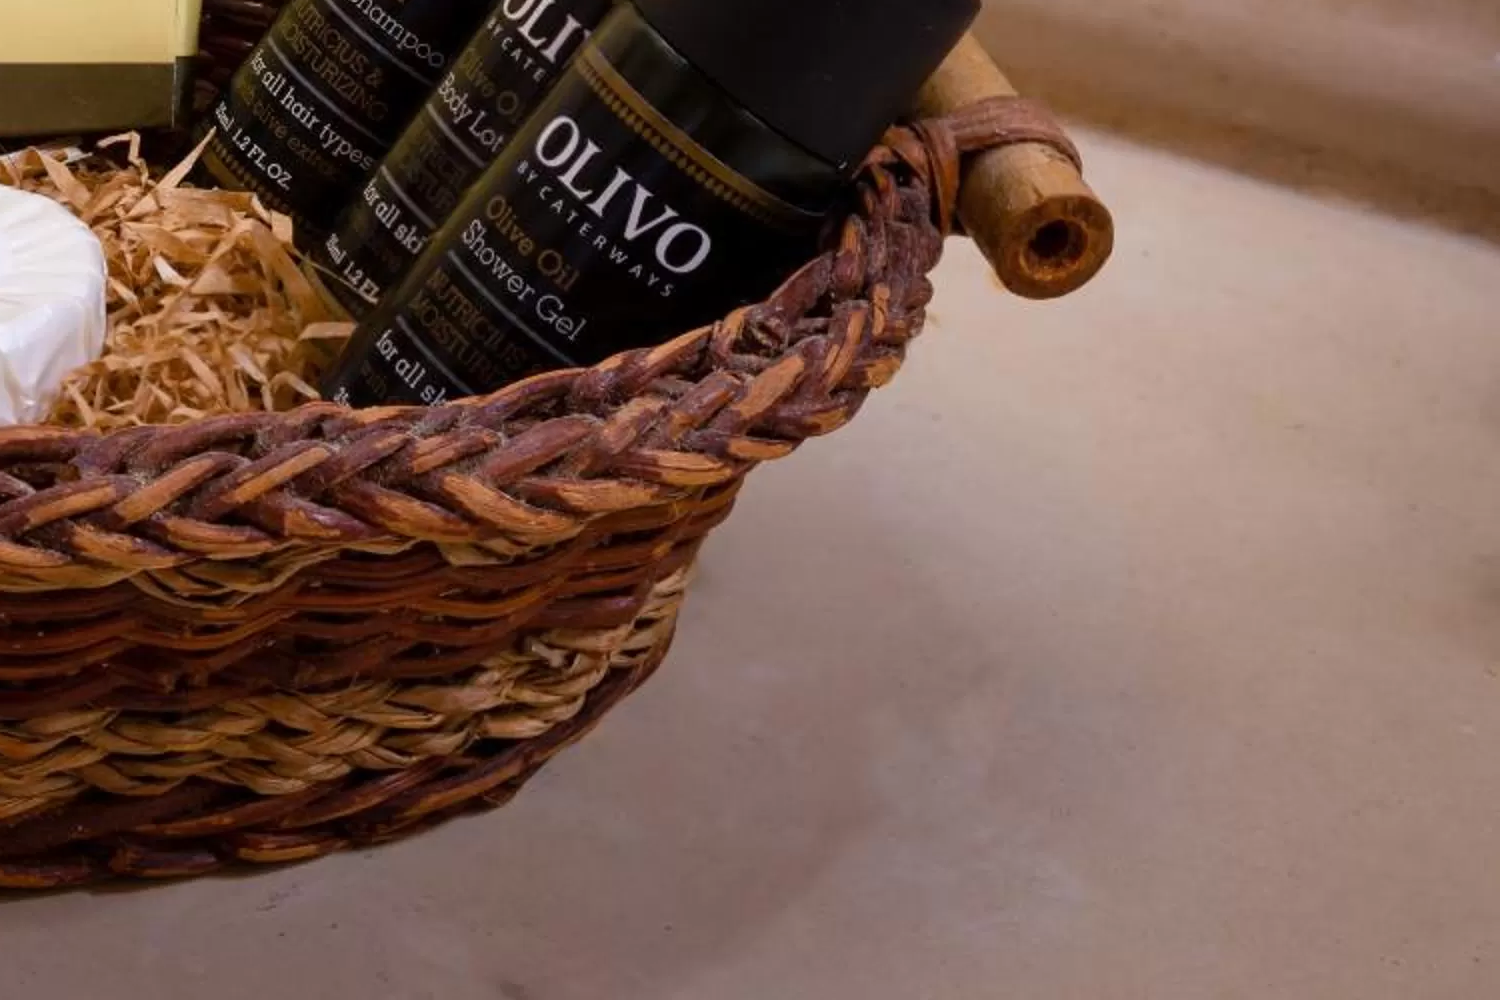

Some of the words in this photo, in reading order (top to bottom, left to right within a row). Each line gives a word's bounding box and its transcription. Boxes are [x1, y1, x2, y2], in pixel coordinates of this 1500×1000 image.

[231, 127, 251, 152] 1.2
[261, 69, 286, 100] all
[278, 88, 321, 131] hair
[319, 121, 376, 173] types
[438, 71, 474, 125] Body
[468, 109, 504, 153] Lot
[375, 200, 401, 230] all
[393, 223, 428, 255] ski
[485, 193, 536, 257] Olive
[536, 248, 581, 294] Oil
[515, 159, 539, 185] BY
[538, 184, 677, 298] CATERWAYS
[534, 114, 713, 274] OLIVO
[461, 218, 536, 302] Shower
[534, 293, 588, 343] Gel
[376, 327, 400, 362] for
[394, 360, 428, 390] all
